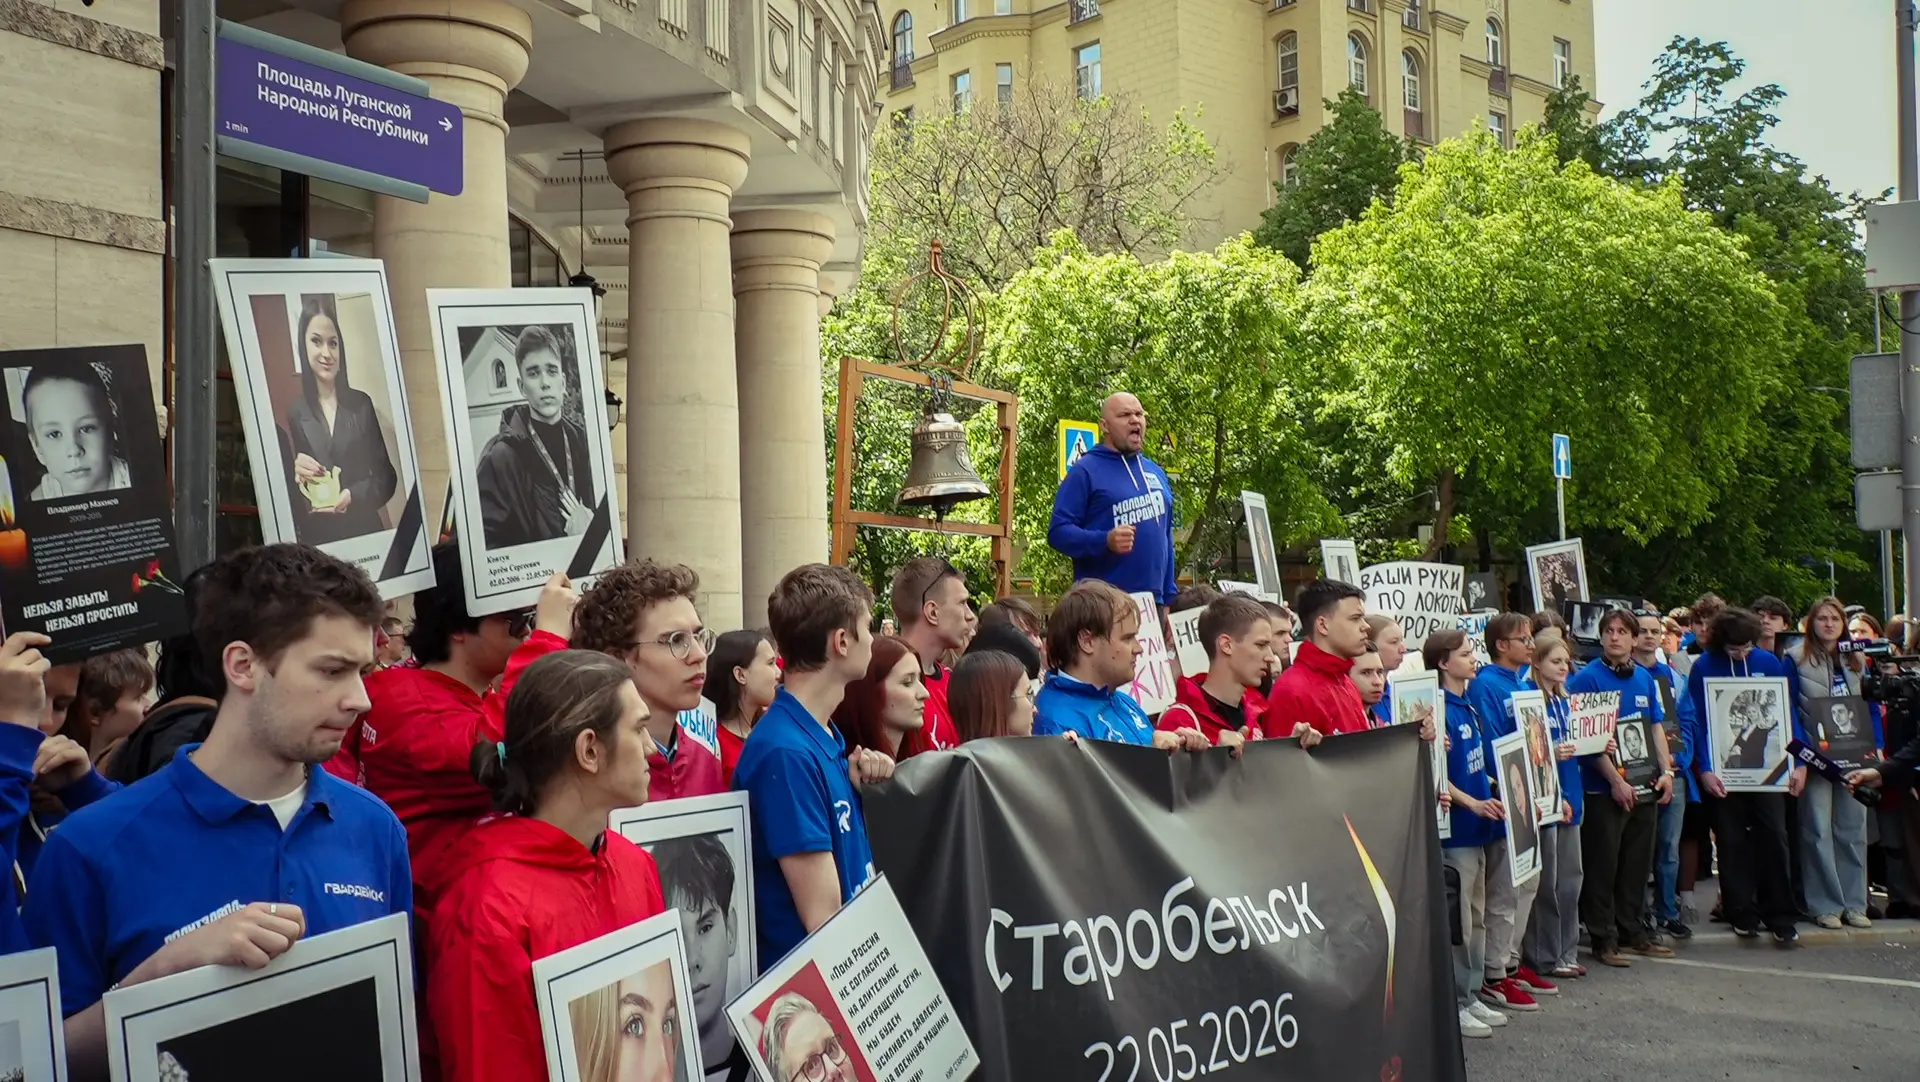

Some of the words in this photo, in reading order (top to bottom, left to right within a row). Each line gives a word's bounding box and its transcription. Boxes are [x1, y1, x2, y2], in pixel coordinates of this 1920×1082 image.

[257, 61, 332, 98] Площадь
[334, 85, 412, 121] Луганской
[231, 123, 249, 134] min
[257, 84, 338, 121] Народной
[342, 108, 429, 146] Республики
[1361, 566, 1412, 590] ВАШИ
[1418, 567, 1460, 591] РУКИ
[23, 602, 64, 619] НЕЛЬЗЯ
[65, 590, 109, 611] ЗАБЫТЬ!
[1378, 589, 1405, 610] ПО
[45, 614, 86, 633] НЕЛЬЗЯ
[86, 601, 139, 624] ПРОСТИТЬ!
[985, 876, 1326, 1001] Старобельск
[1084, 992, 1298, 1082] 2205.2026
